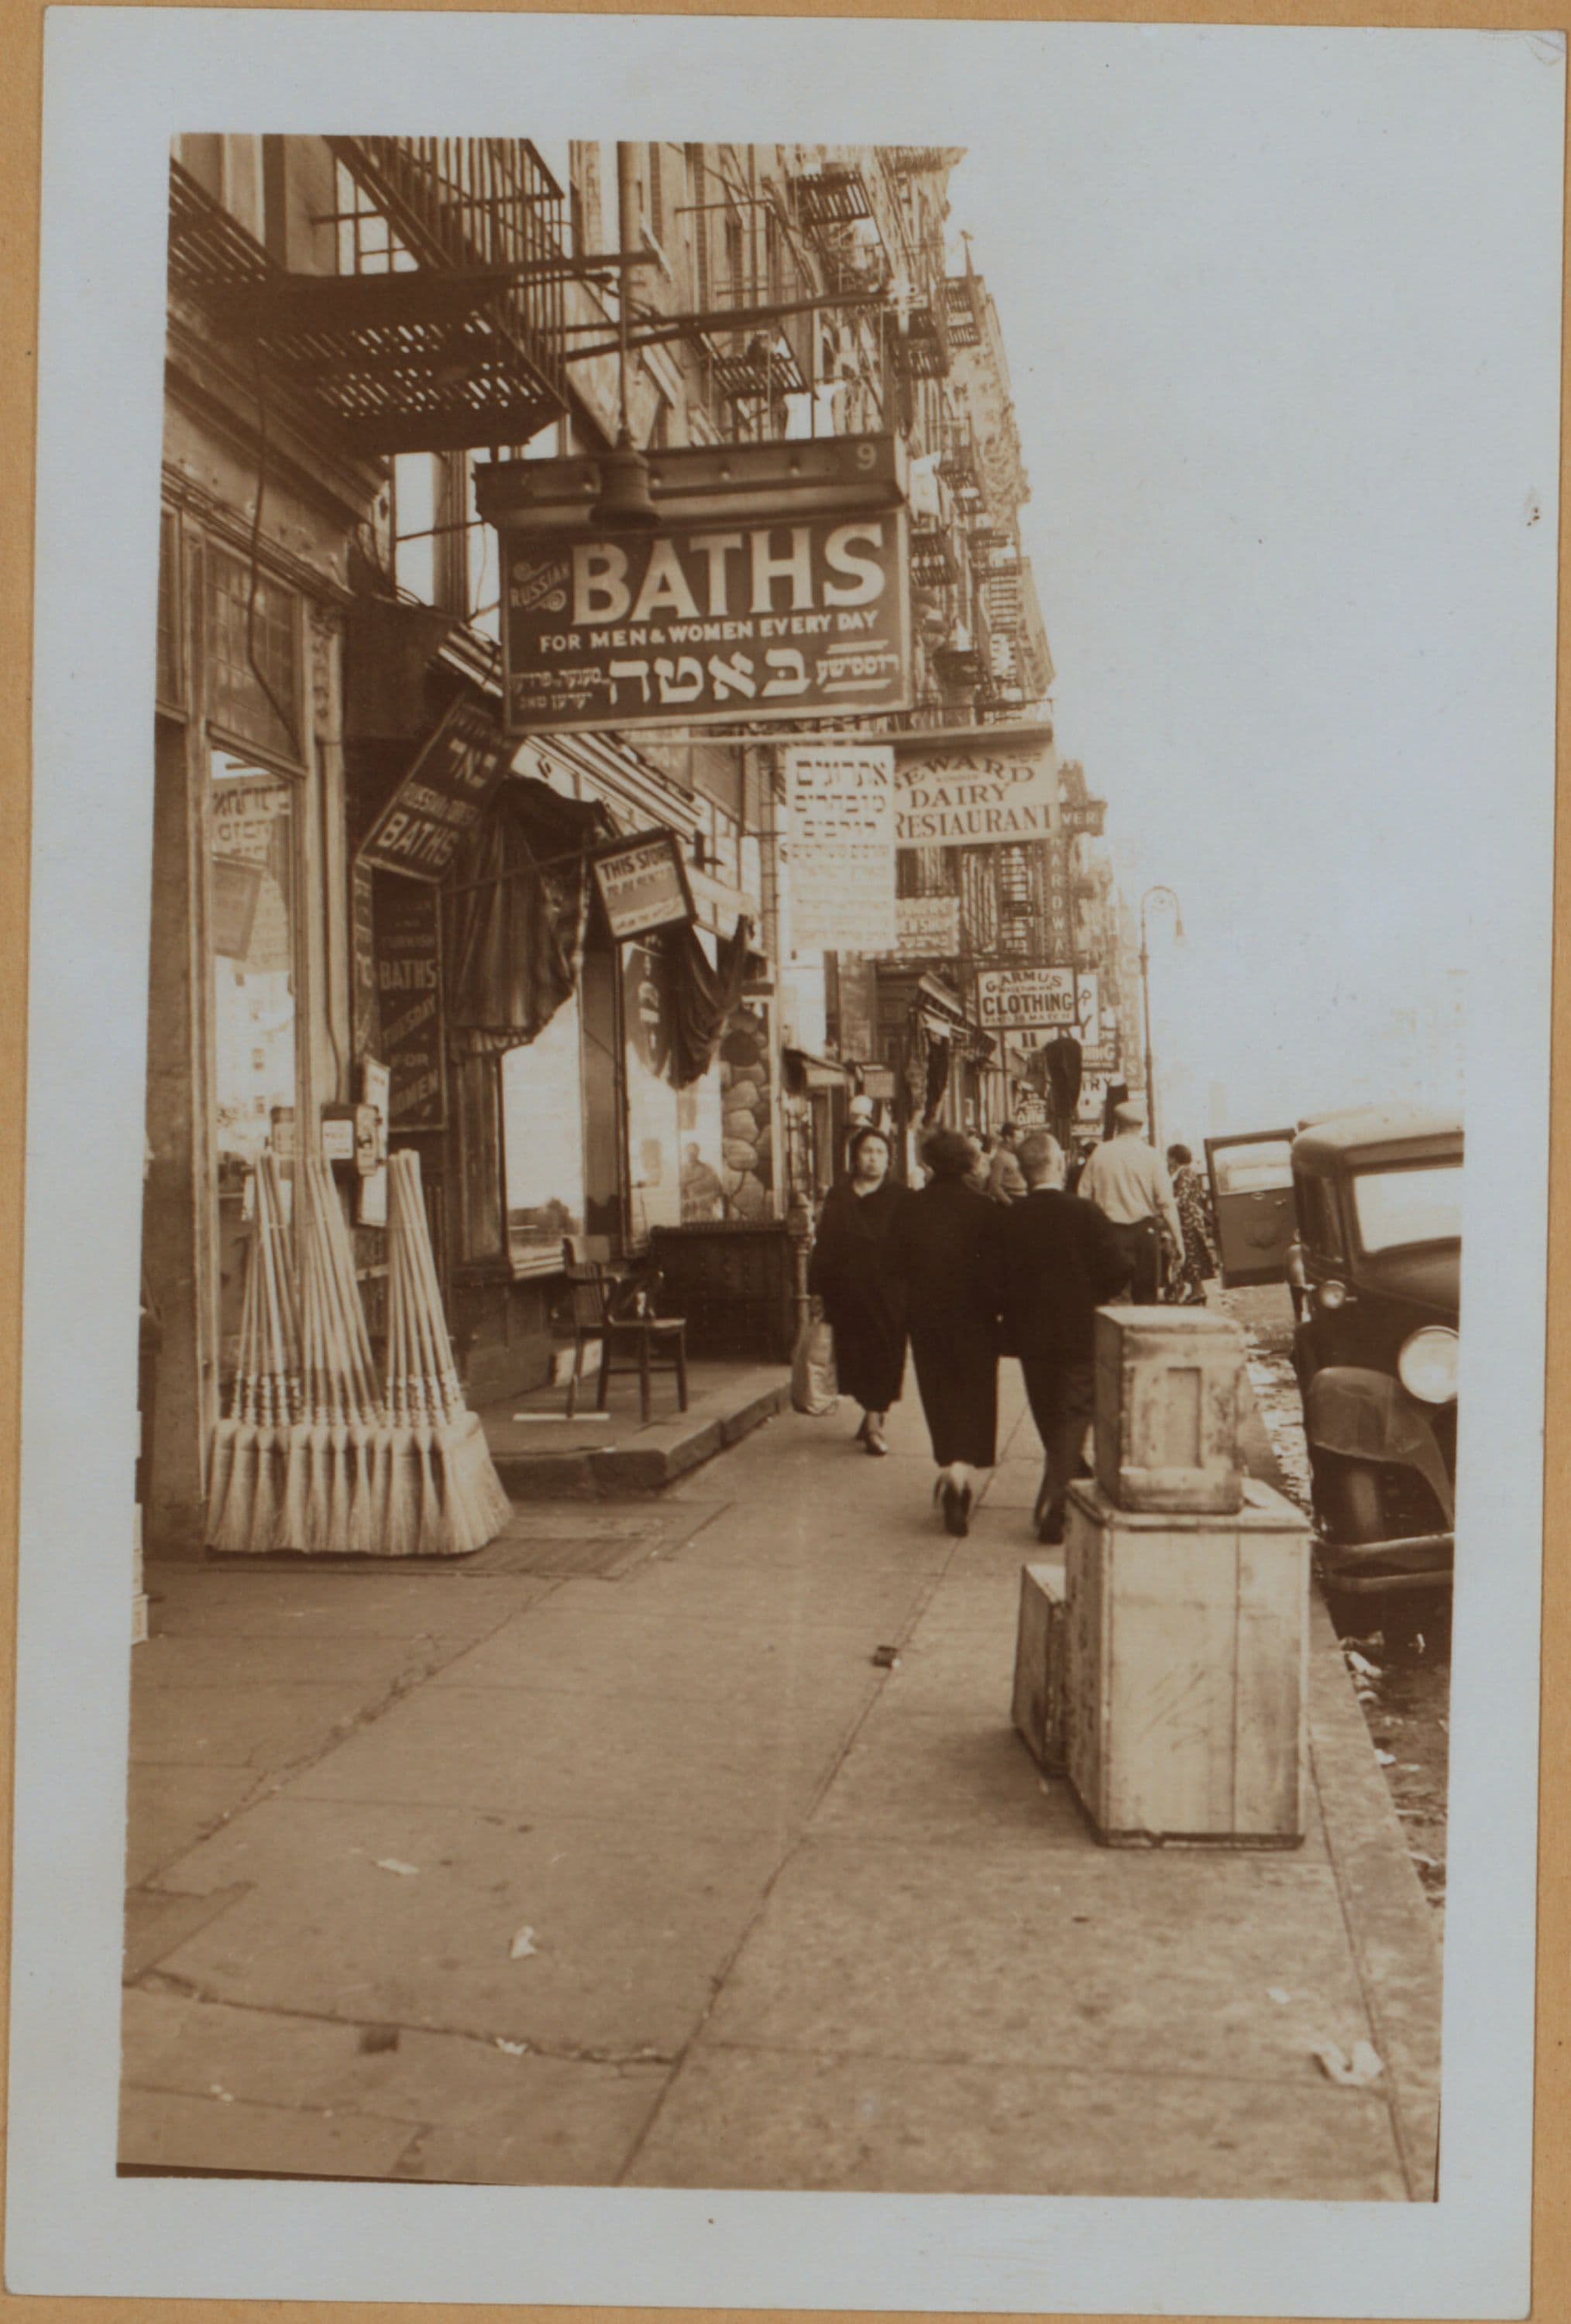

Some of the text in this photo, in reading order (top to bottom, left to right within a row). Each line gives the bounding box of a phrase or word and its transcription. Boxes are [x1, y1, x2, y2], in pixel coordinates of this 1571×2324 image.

[858, 442, 877, 470] 9
[510, 562, 569, 608] RUSSIAN
[572, 524, 885, 626] BATHS
[540, 634, 581, 653] FOR
[760, 615, 830, 638] EVERY
[839, 611, 878, 630] DAY
[910, 782, 1009, 809] DAIRY
[895, 805, 1051, 839] RESTAURANT
[377, 812, 459, 867] BATHS
[600, 853, 635, 881] THIS
[380, 959, 438, 990] BATHS
[985, 971, 1062, 992] GARMUS
[982, 992, 1074, 1016] CLOTHING
[390, 1052, 429, 1068] FOR
